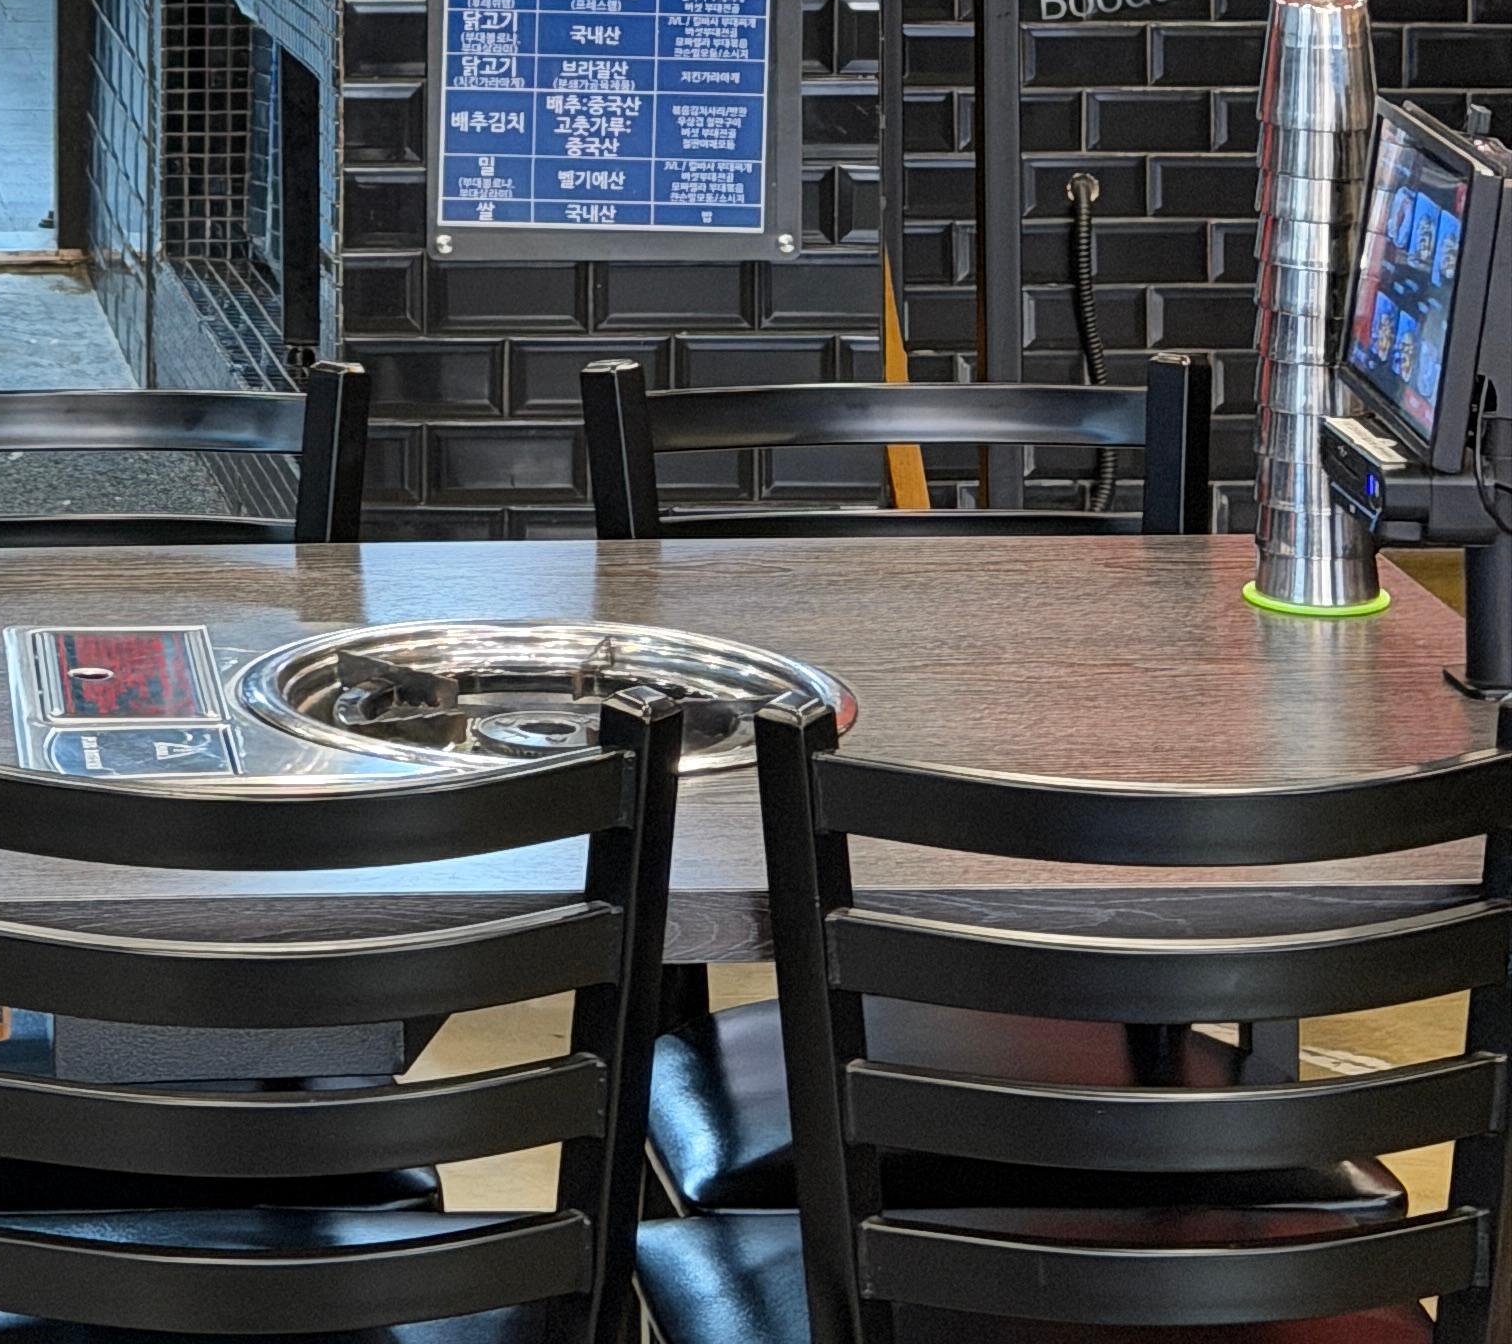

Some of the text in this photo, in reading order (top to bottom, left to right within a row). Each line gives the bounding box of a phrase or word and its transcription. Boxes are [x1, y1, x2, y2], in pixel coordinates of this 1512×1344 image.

[463, 11, 518, 32] 닭고기
[569, 25, 621, 45] 국내산
[461, 56, 517, 78] 닭고기
[560, 60, 629, 80] 브라질산
[546, 95, 642, 116] 배추:중국산
[451, 111, 525, 134] 배추김치
[553, 116, 631, 137] 고춧가루:
[565, 137, 620, 157] 중국산
[478, 156, 495, 177] 밀
[558, 170, 626, 190] 벨기에산
[476, 201, 495, 221] 쌀
[565, 204, 618, 223] 국내산
